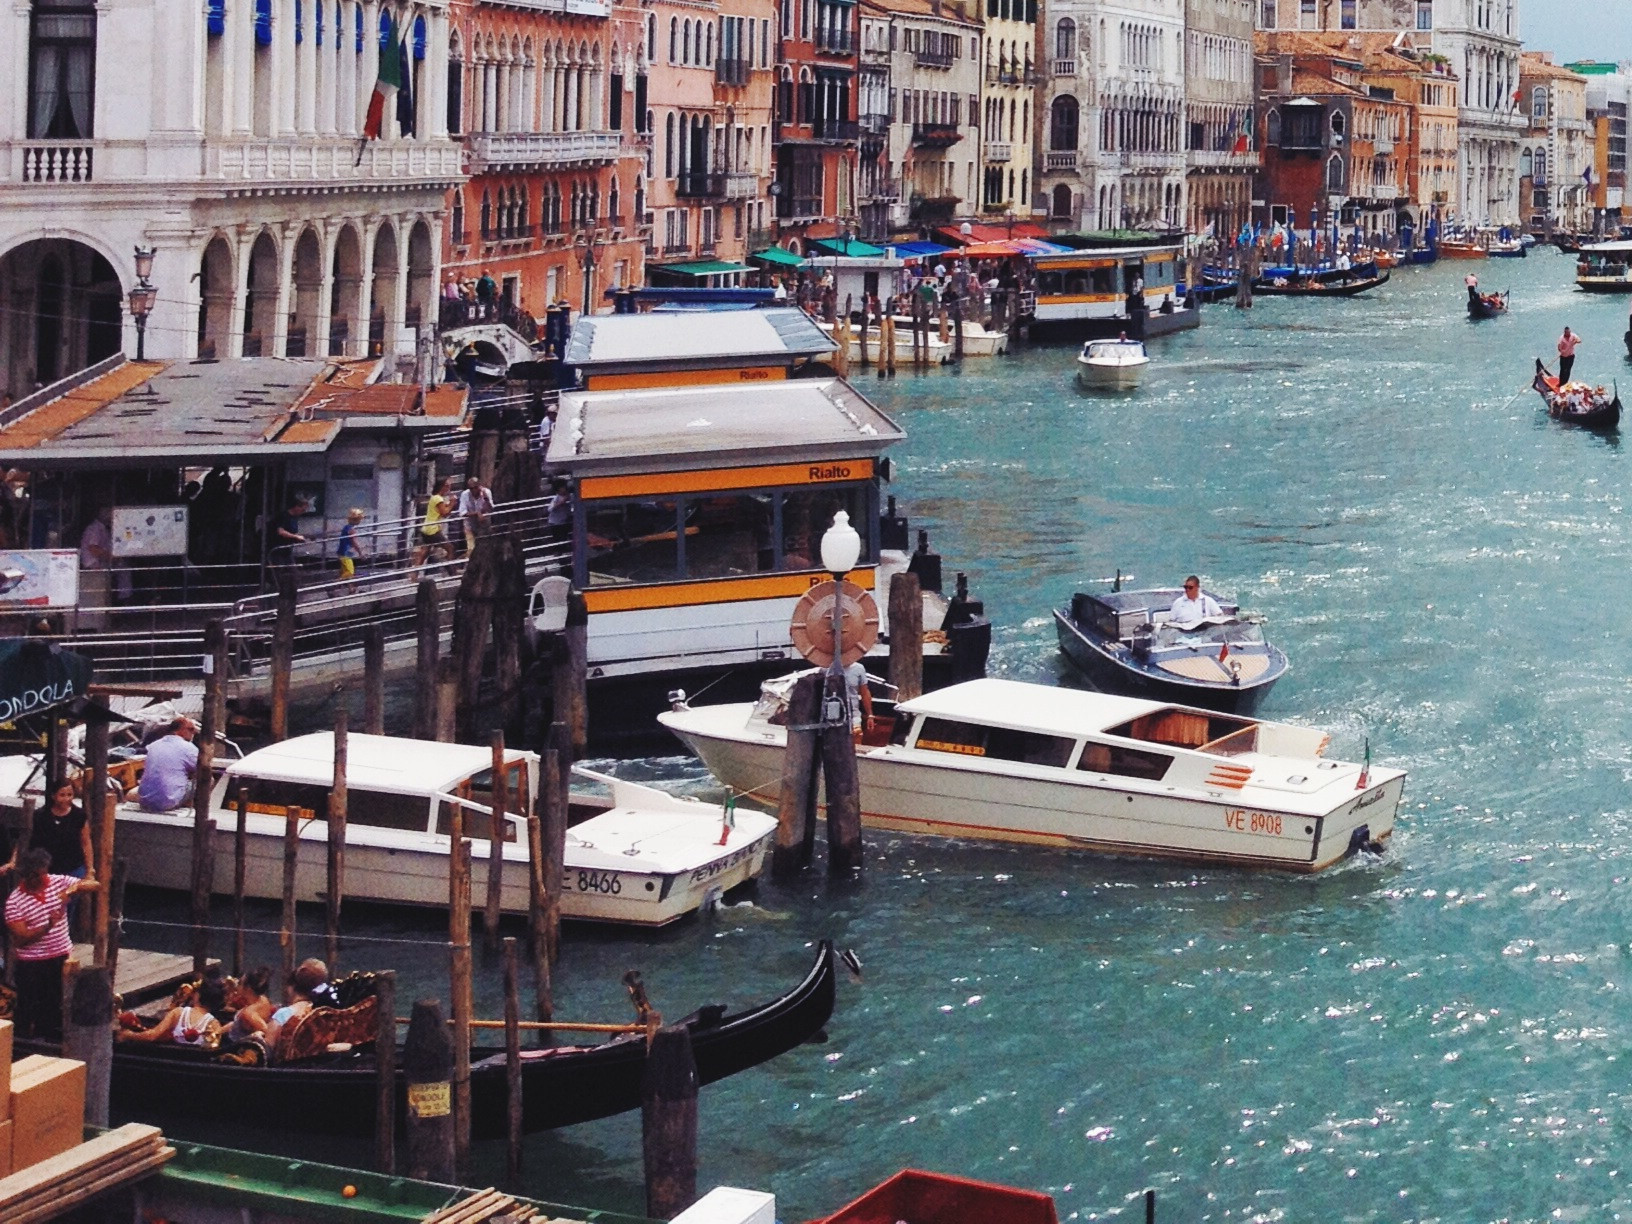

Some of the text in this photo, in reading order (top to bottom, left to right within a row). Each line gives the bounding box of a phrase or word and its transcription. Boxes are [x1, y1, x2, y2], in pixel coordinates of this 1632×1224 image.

[809, 465, 851, 479] Rialto
[0, 679, 74, 720] ONDOLA
[1225, 808, 1283, 836] VE 8908
[578, 870, 622, 894] 8466
